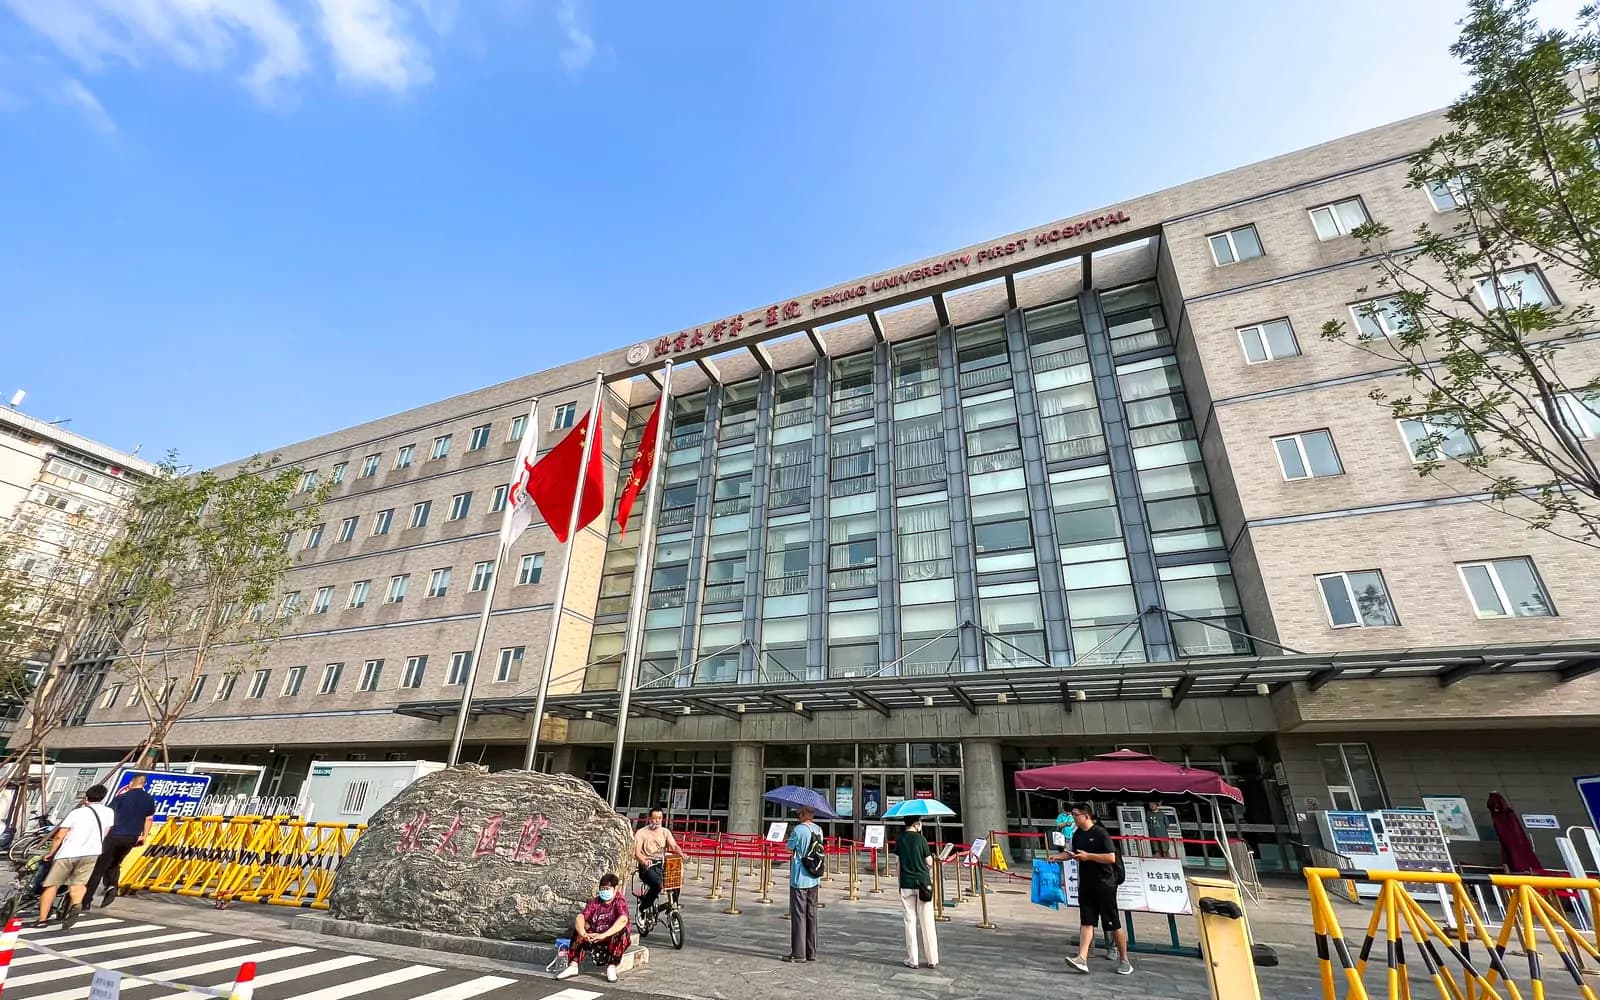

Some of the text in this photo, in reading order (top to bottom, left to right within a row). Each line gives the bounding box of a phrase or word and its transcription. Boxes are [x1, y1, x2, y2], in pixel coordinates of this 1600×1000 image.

[812, 210, 1131, 310] PEKING UNIVERSITY FIRST HOSPITAL
[654, 300, 802, 358] 北京大学第一医院
[147, 779, 205, 798] 消防车道
[154, 800, 197, 817] 止占用
[396, 810, 551, 865] 北大医院
[1146, 871, 1181, 880] 社会车辆
[1149, 883, 1183, 893] 禁止入内
